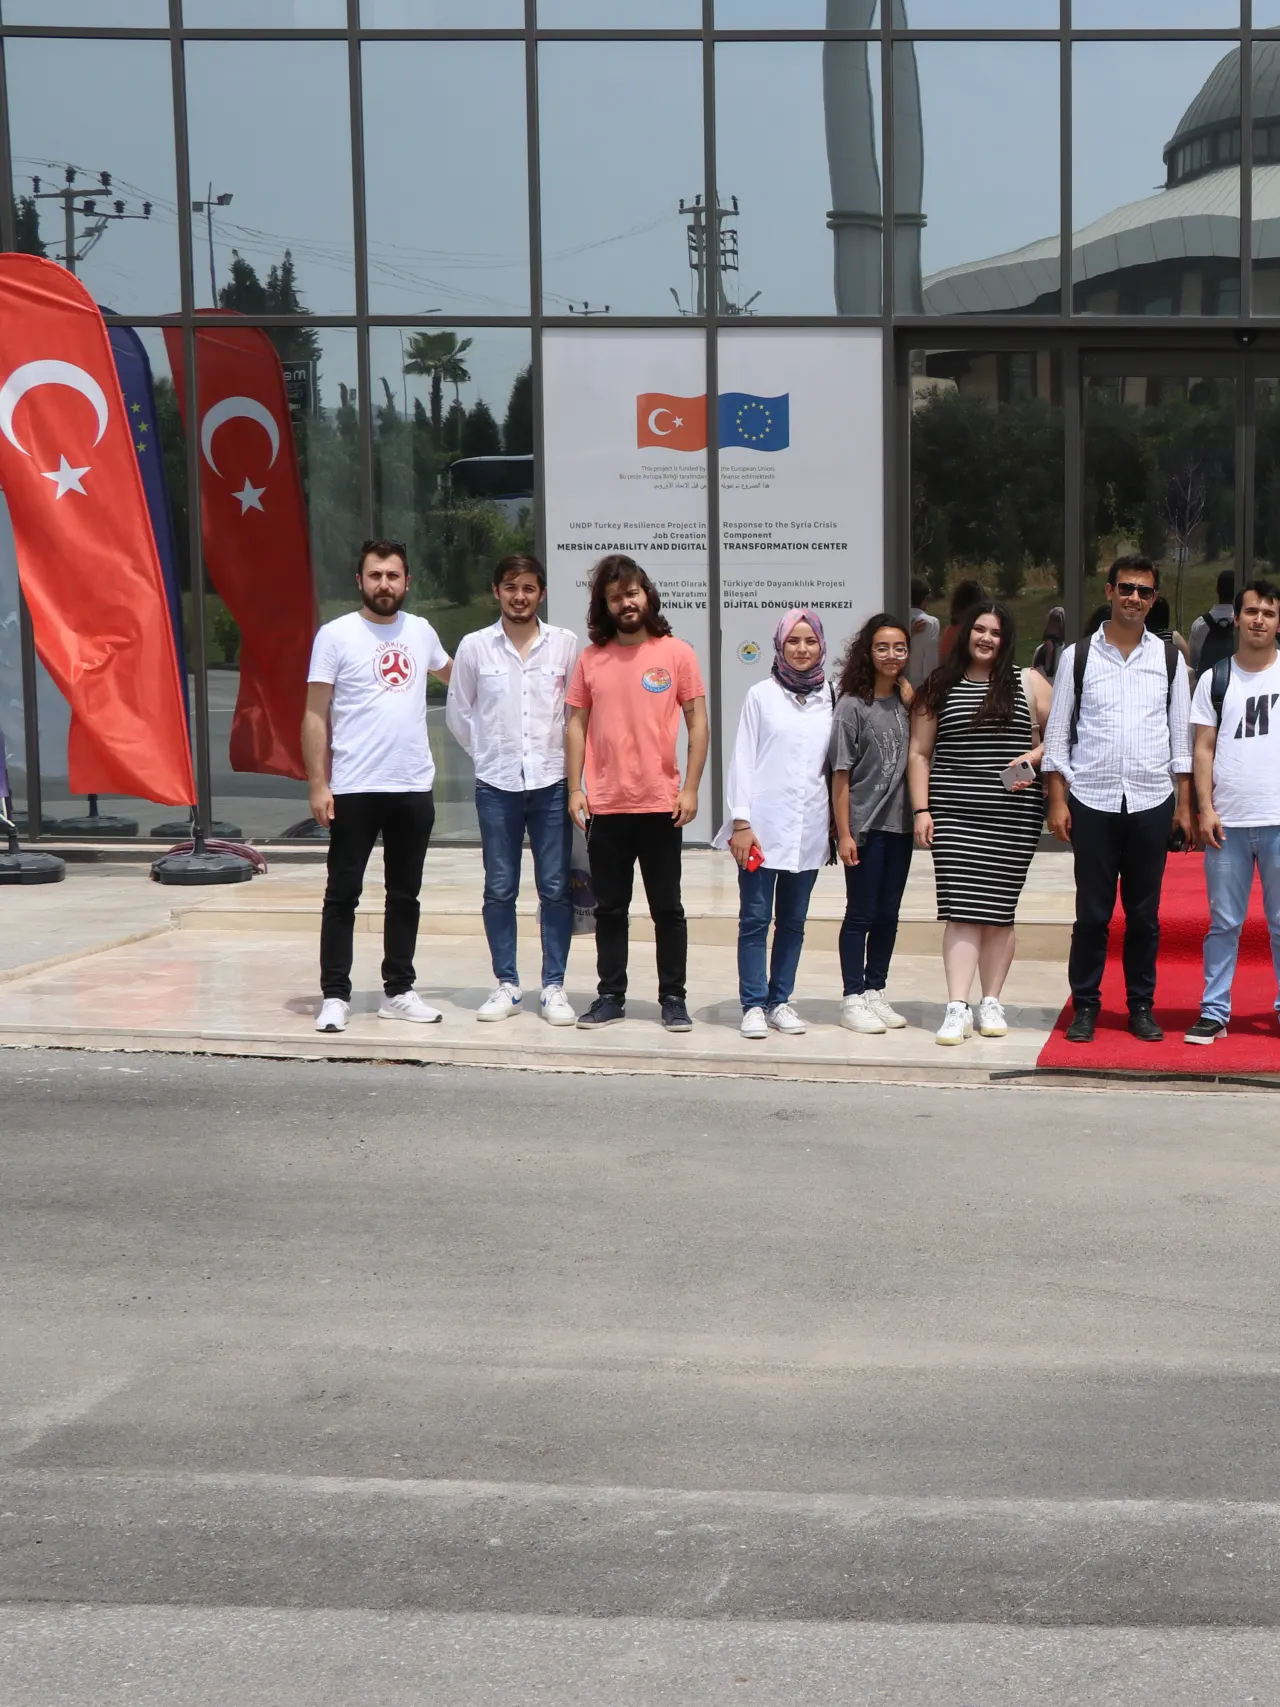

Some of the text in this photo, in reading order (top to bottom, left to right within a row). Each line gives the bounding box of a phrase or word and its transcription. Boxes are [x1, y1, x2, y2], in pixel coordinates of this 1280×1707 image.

[653, 465, 672, 473] project
[731, 465, 756, 473] European
[594, 522, 622, 530] Turkey
[667, 522, 697, 530] Project
[723, 521, 763, 530] Response
[790, 521, 812, 530] Syria
[813, 521, 838, 529] Crisis
[723, 532, 772, 540] Component
[557, 541, 848, 551] MERSİN CAPABILITY AND DIGITAL TRANSFORMATION CENTER
[658, 580, 679, 588] Yanıt
[681, 580, 707, 588] Olarak
[722, 580, 765, 588] Türkiye'de
[767, 580, 815, 588] Dayanıklılık
[816, 580, 845, 588] Projesi
[671, 590, 707, 598] Yaratımı
[723, 590, 758, 598] Bileşeni
[660, 600, 853, 610] KİNLİK VE DİJİTAL DÖNÜŞÜM MERKEZİ
